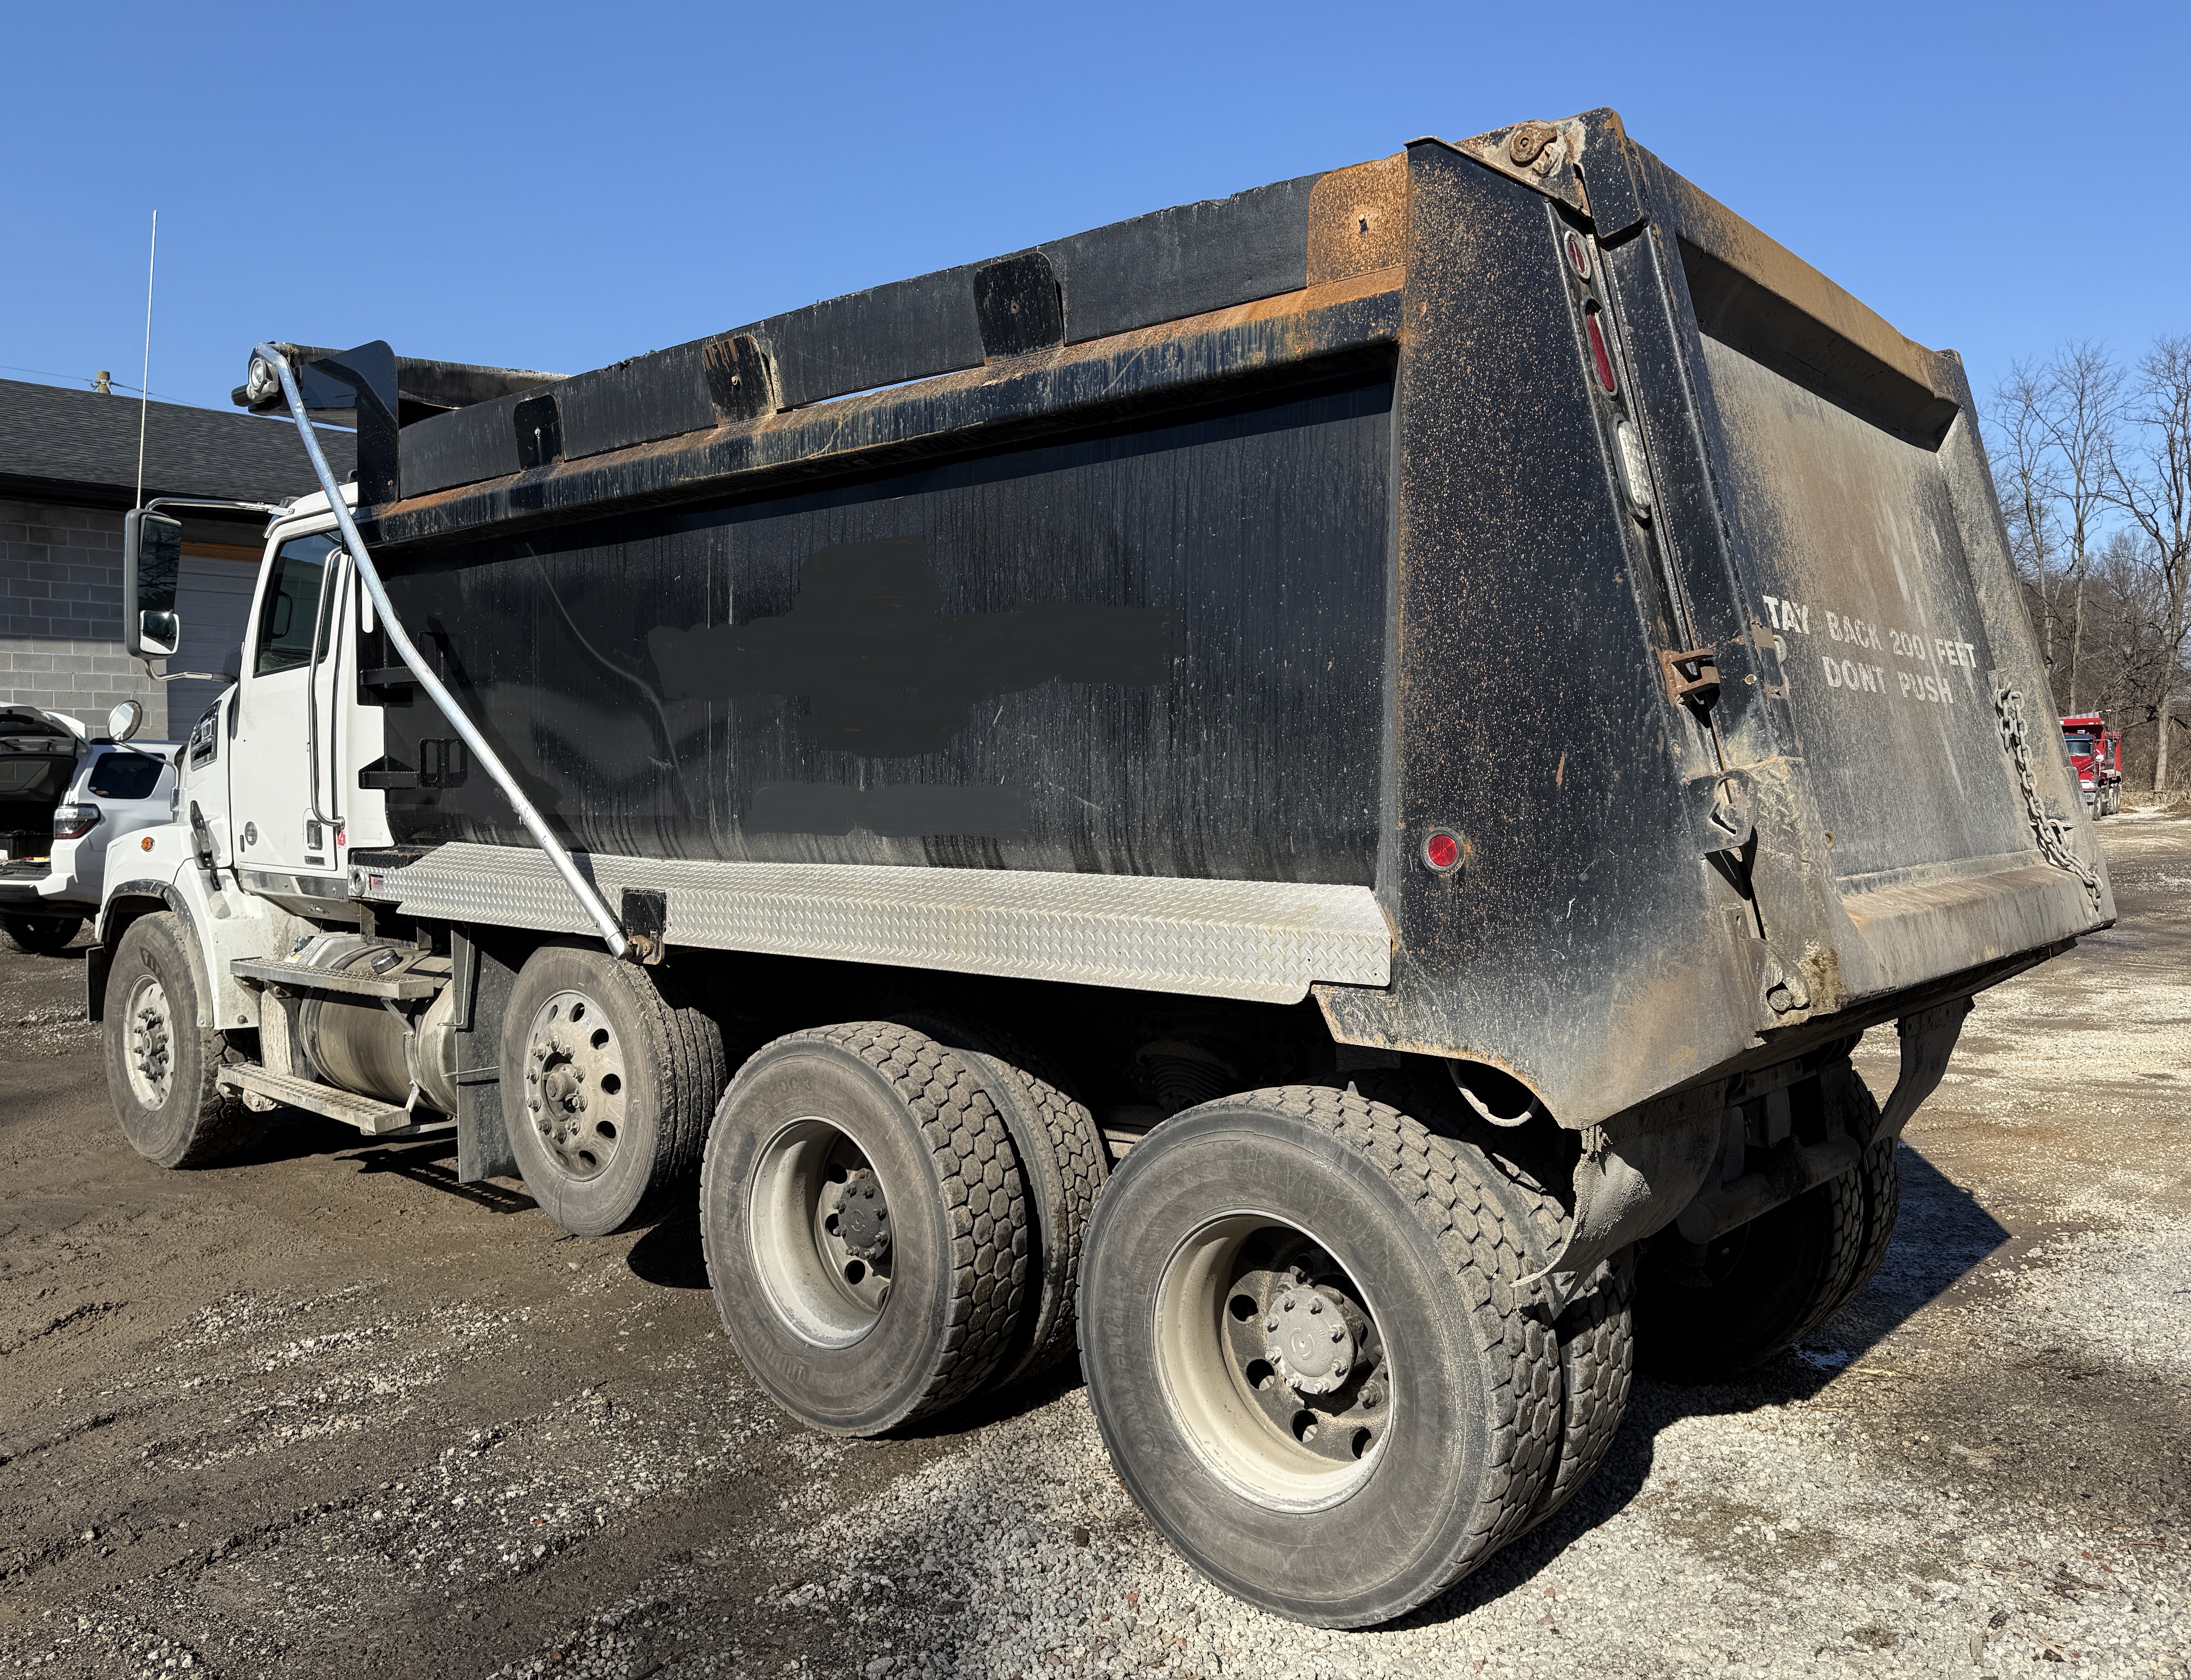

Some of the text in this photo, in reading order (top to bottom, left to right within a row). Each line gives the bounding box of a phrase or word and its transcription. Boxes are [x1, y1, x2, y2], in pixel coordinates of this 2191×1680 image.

[1763, 595, 1977, 668] TAY BACK 200 FEET
[1822, 656, 1954, 704] DONT PUSH
